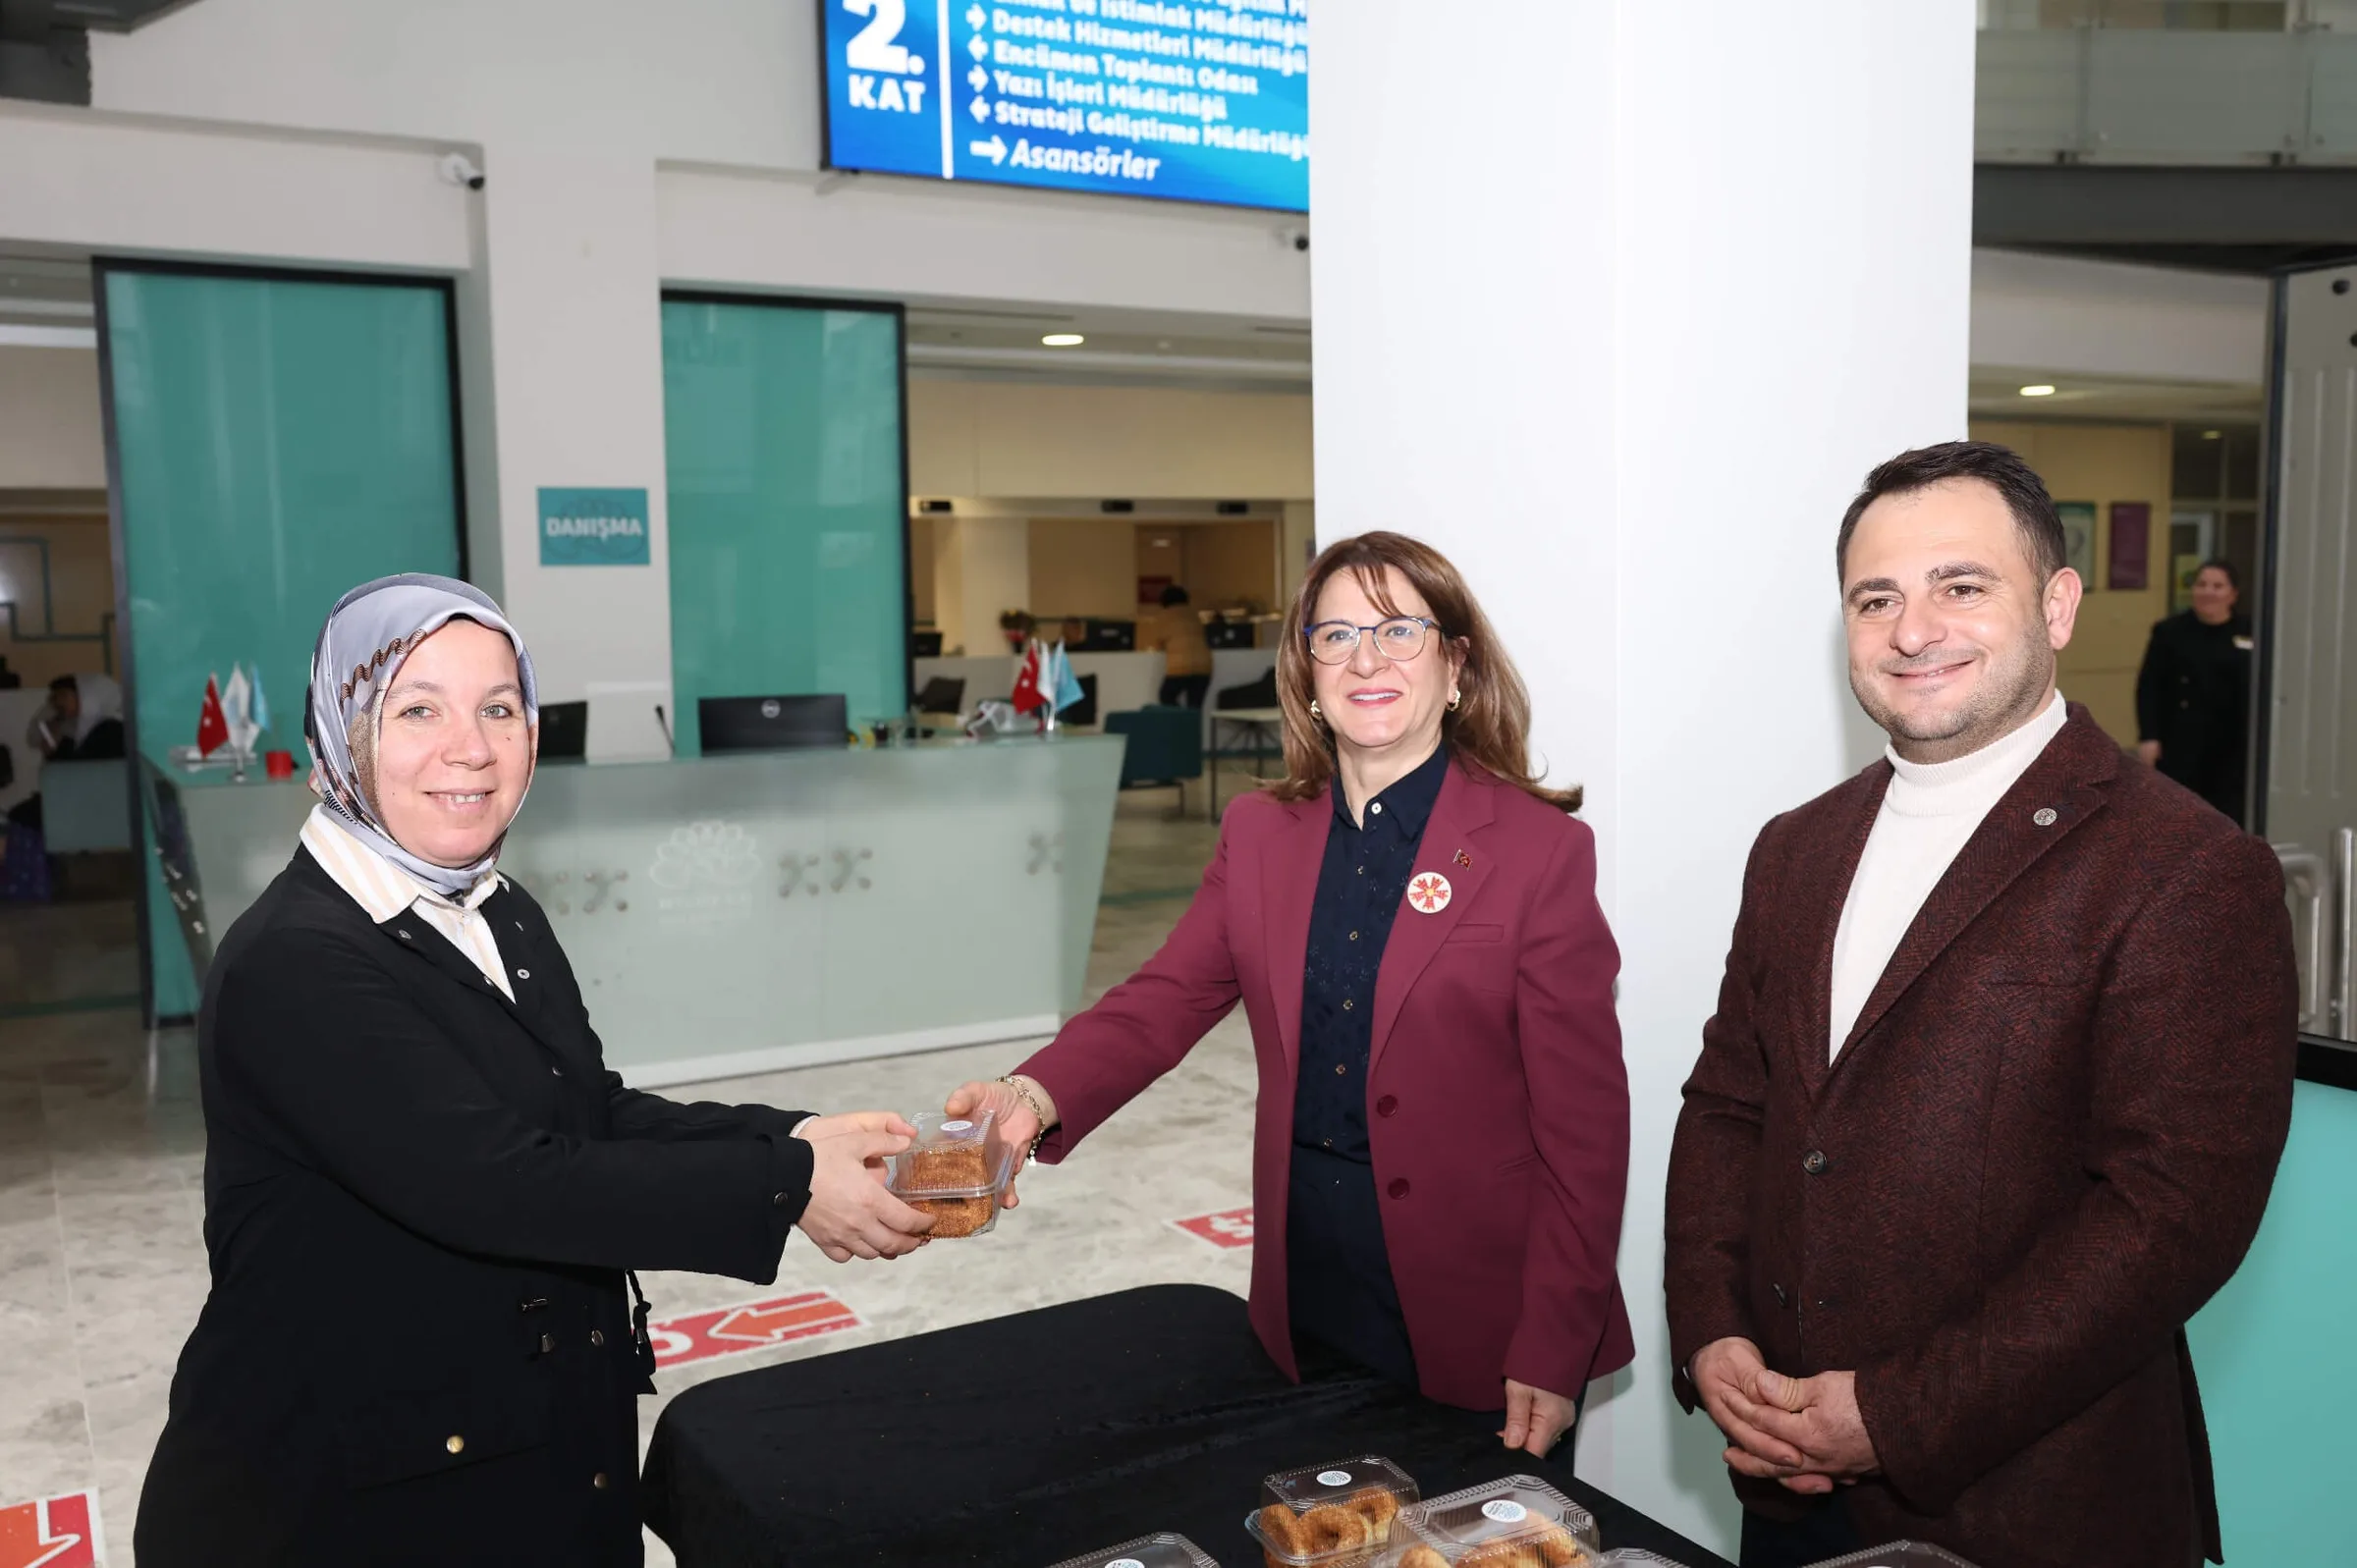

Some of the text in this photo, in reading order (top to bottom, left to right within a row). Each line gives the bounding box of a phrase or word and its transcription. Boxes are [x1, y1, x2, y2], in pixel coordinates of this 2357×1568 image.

[843, 0, 925, 76] 2.
[993, 9, 1307, 77] Destek Hizmetleri Müdürlüğü
[994, 39, 1258, 95] Encümen Toplantı Odası
[849, 74, 926, 114] KAT
[993, 69, 1228, 123] Yazı İşleri Müdürlüğü
[994, 100, 1085, 135] Strateji
[1087, 111, 1200, 145] Geliştirme
[1010, 137, 1162, 181] Asansörler
[546, 516, 643, 542] DANIŞMA
